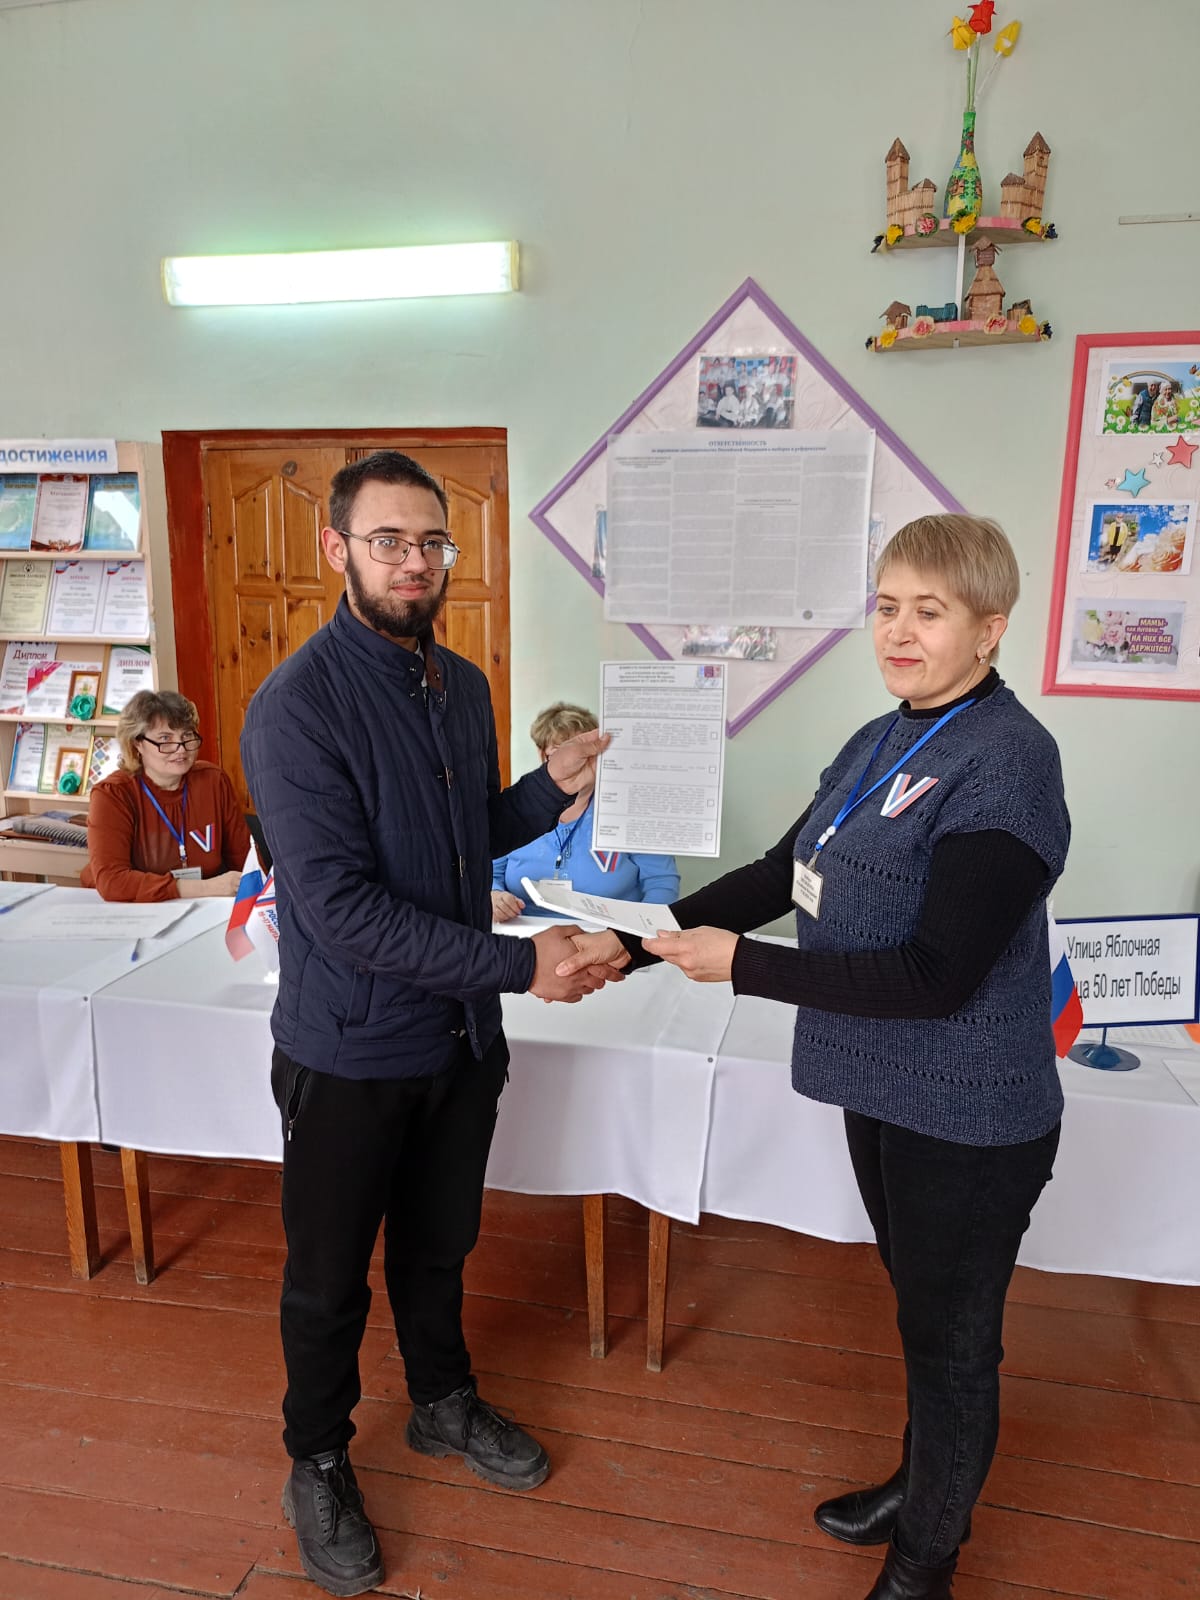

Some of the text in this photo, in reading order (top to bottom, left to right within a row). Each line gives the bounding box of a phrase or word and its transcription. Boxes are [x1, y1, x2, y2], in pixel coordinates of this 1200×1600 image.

[1067, 934, 1160, 962] Улица Яблочная
[1093, 973, 1107, 998] 50
[1110, 978, 1131, 998] лет
[1135, 971, 1181, 1000] Победы
